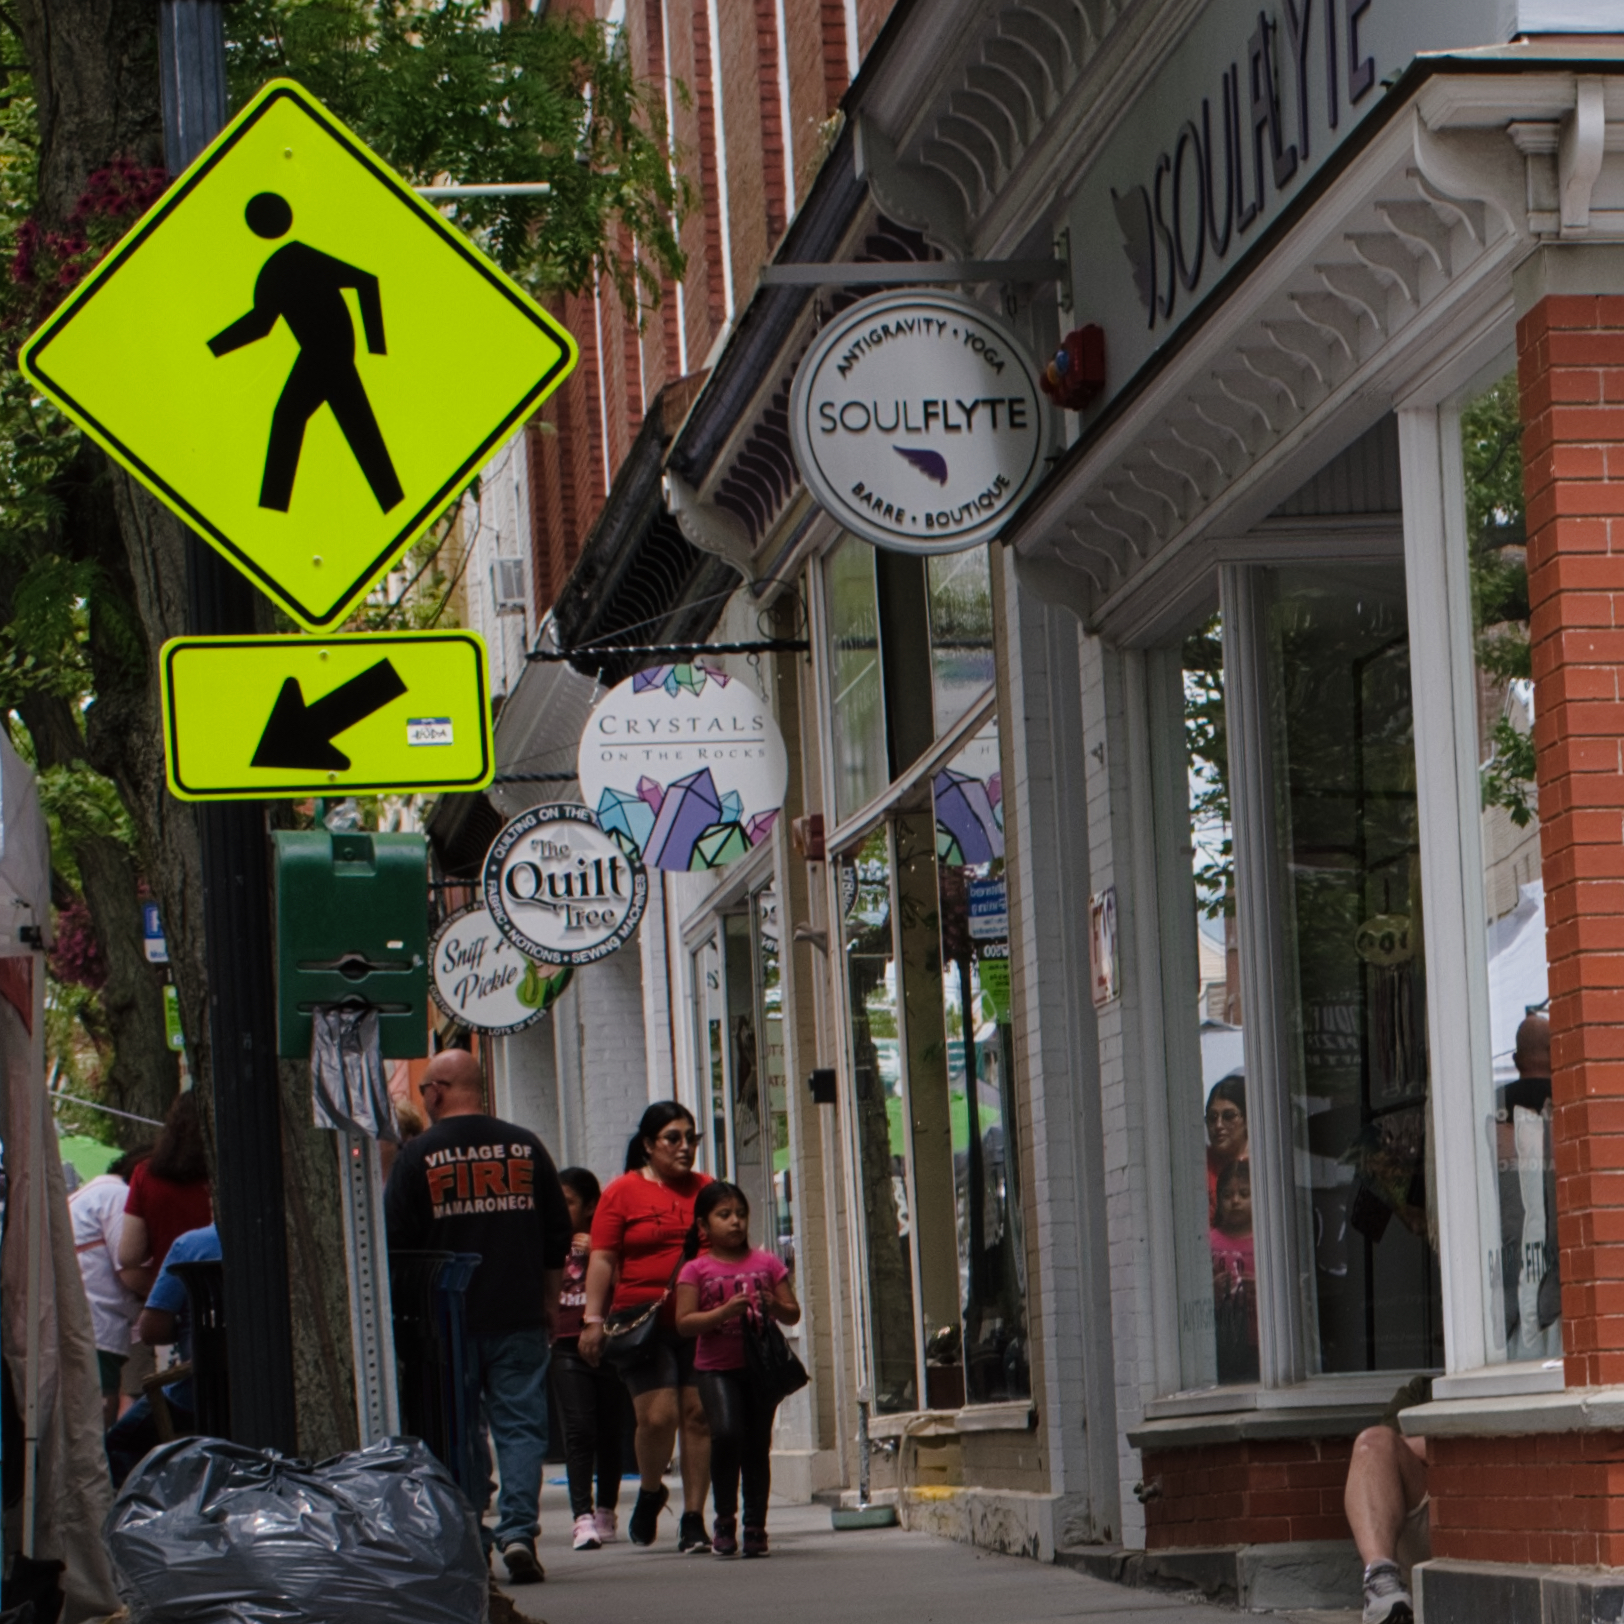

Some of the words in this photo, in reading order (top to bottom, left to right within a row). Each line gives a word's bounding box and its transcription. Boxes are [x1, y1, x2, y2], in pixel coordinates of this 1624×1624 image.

[836, 317, 947, 380] ANTIGRAVITY
[962, 328, 1006, 377] YOGA
[818, 396, 1029, 435] SOULFLYTE
[851, 480, 907, 524] BARRE
[924, 473, 1012, 530] BOUTIQUE
[599, 714, 765, 736] CRYSTALS
[600, 750, 629, 763] ON
[642, 749, 684, 761] THE
[698, 747, 766, 760] ROCKS
[494, 814, 538, 859] QUILTING
[538, 806, 560, 820] ON
[563, 805, 588, 821] THE
[531, 839, 571, 860] The
[504, 855, 627, 914] Quilt
[486, 879, 508, 926] FABRIC
[507, 928, 562, 964] NOTIONS
[570, 938, 622, 964] SEWING
[618, 873, 646, 938] MACHINES
[556, 903, 617, 929] Tree
[442, 934, 489, 974] Sniff
[453, 963, 519, 1011] Pickle
[429, 983, 454, 1019] CUSTOM
[488, 1026, 512, 1037] LOTS
[513, 1022, 526, 1033] OF
[424, 1144, 506, 1168] VILLAGE
[510, 1143, 532, 1158] OF
[425, 1158, 534, 1204] FIRE
[432, 1195, 536, 1220] MAMARONECK
